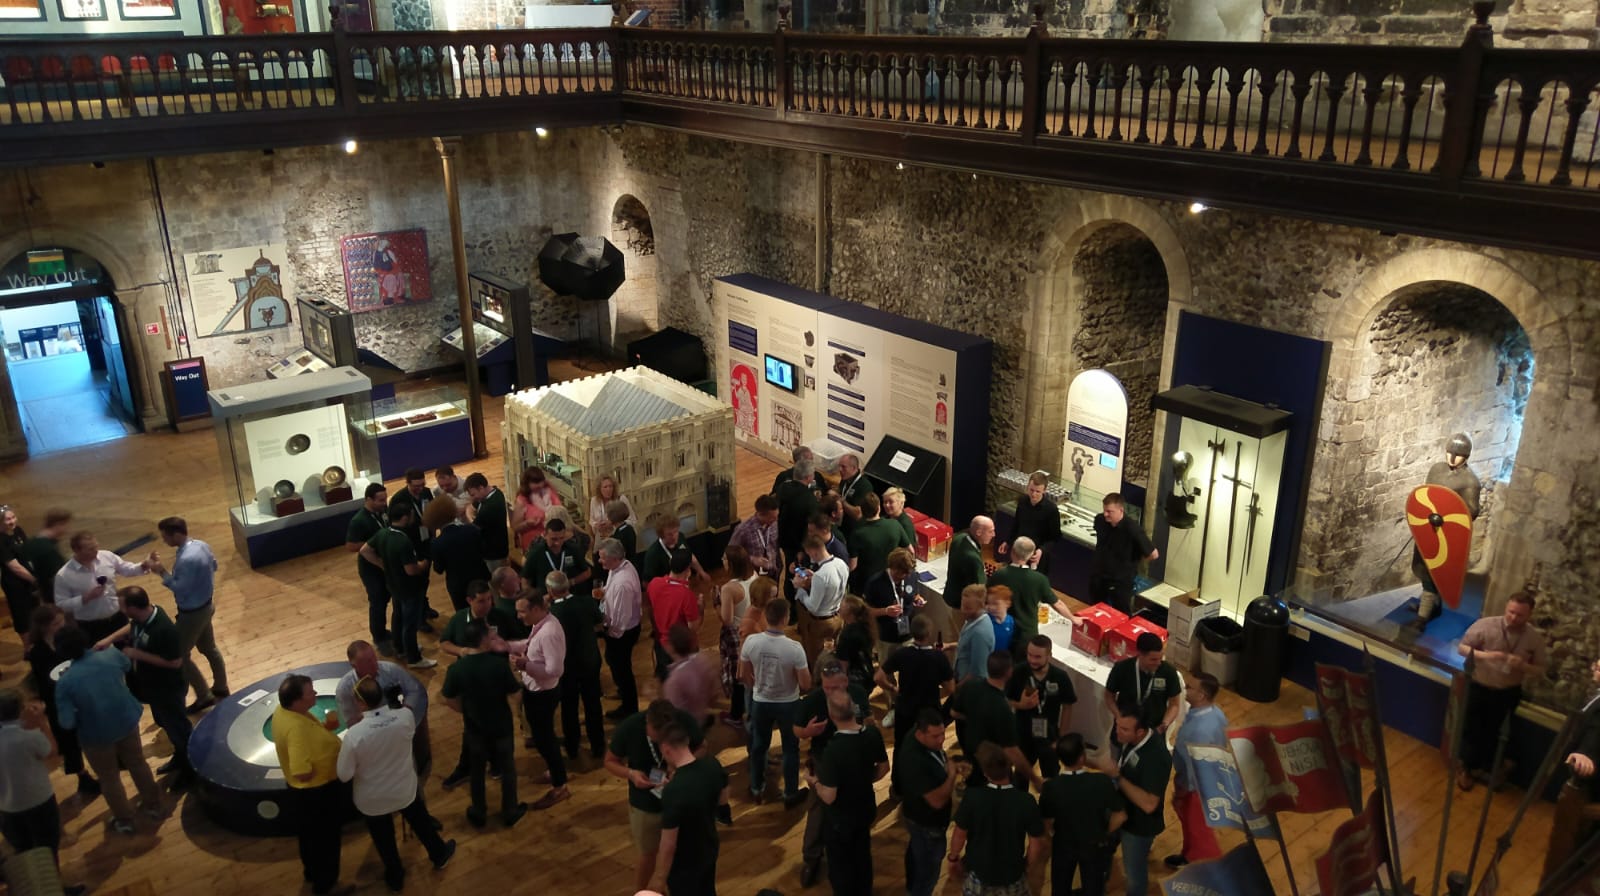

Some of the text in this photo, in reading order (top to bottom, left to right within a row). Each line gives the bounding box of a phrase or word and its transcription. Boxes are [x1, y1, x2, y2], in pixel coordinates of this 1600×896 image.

[7, 267, 88, 290] Way Out
[175, 374, 188, 382] Way
